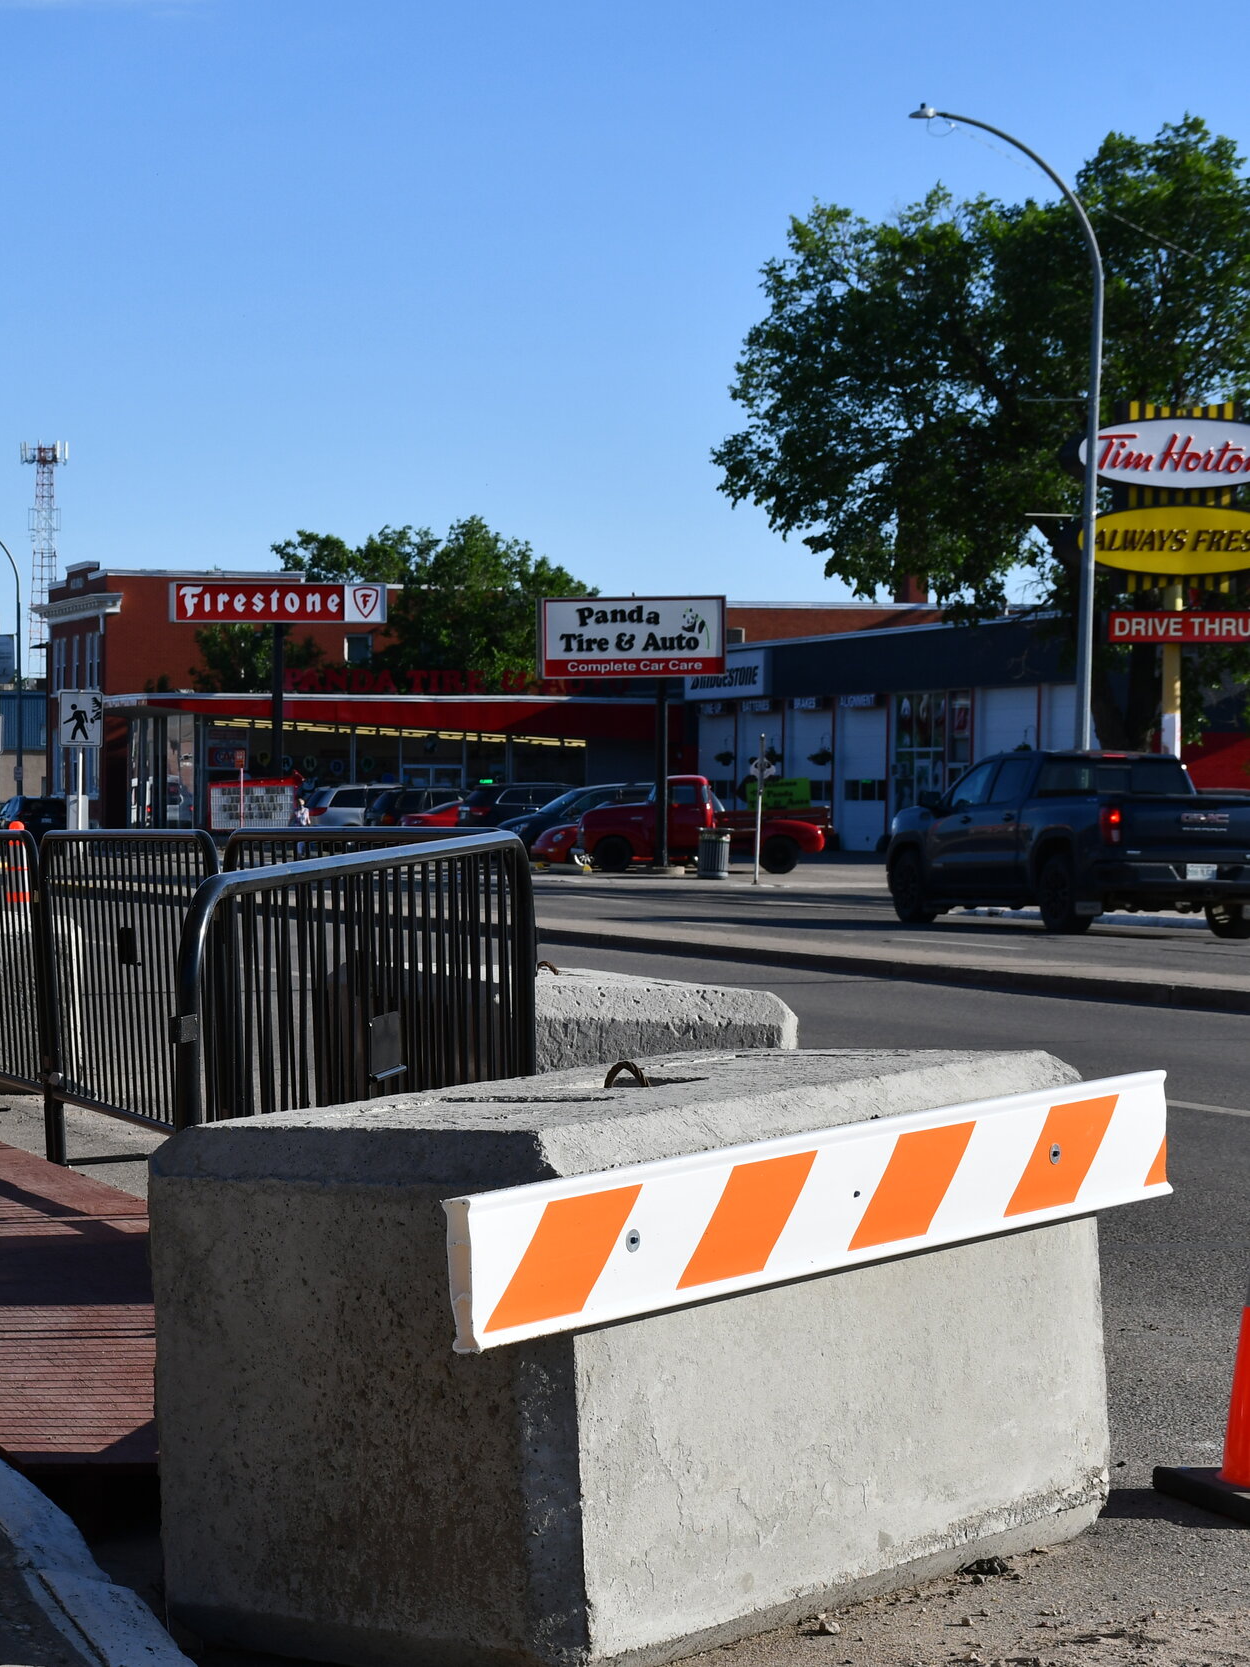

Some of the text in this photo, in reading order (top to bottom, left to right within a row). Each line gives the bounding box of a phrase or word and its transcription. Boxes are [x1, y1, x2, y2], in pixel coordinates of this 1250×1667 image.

[1097, 433, 1154, 471] Tim
[1094, 528, 1250, 552] ALWAYS FRES
[179, 586, 341, 618] Firestone
[576, 605, 661, 627] Panda
[1113, 618, 1250, 636] DRIVE THRU
[559, 632, 700, 652] Tire & Auto
[567, 660, 703, 674] Complete Car Care
[284, 667, 397, 693] PANDA
[405, 669, 486, 693] TIRE
